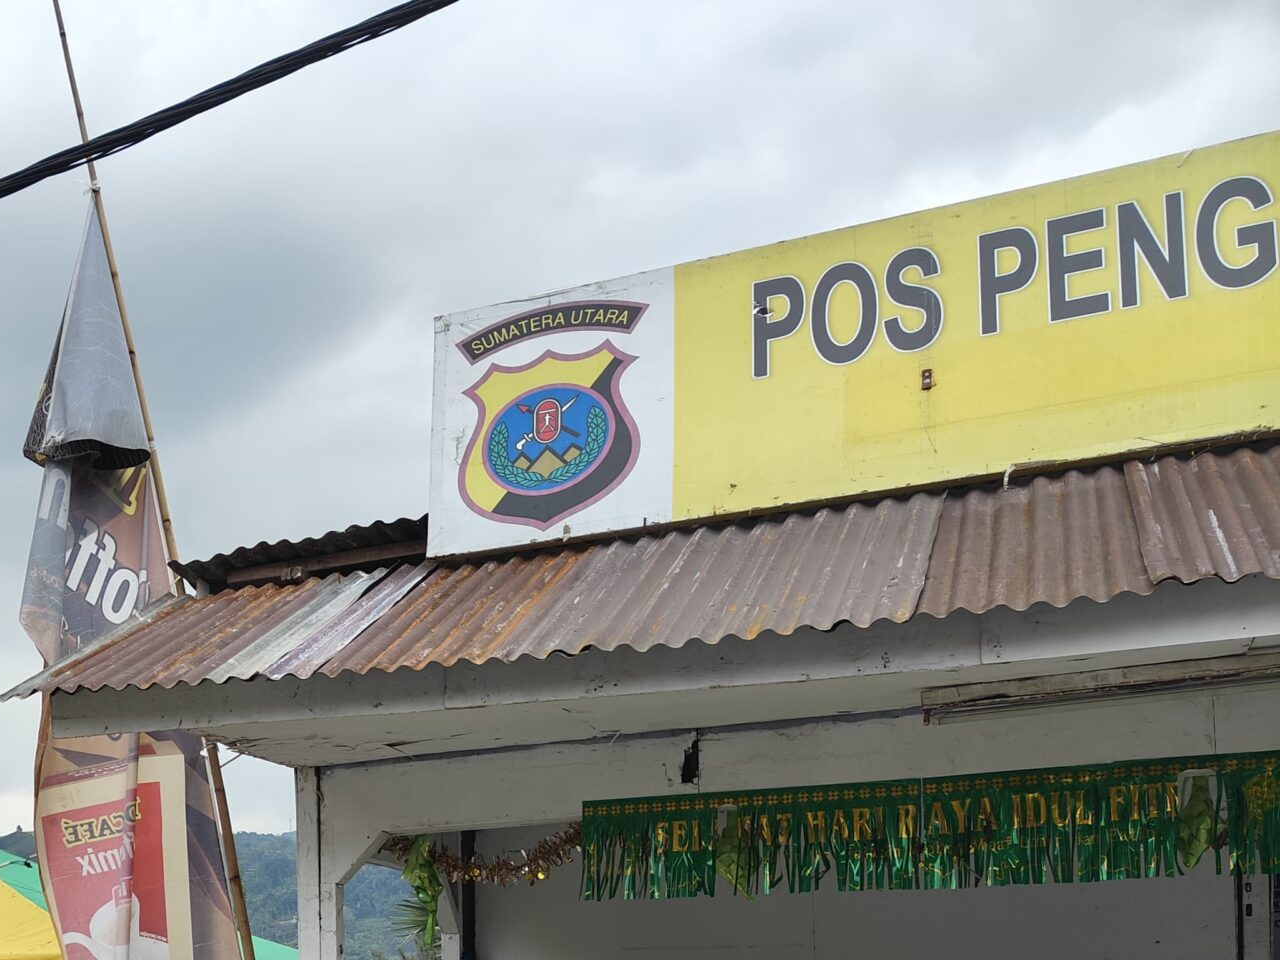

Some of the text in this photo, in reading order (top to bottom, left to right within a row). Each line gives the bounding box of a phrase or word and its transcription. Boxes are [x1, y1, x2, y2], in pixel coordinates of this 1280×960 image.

[752, 176, 1279, 378] POS PENG
[471, 308, 629, 354] SUMATERA UTARA
[1012, 790, 1093, 829] IDUL
[1110, 781, 1179, 823] FIT
